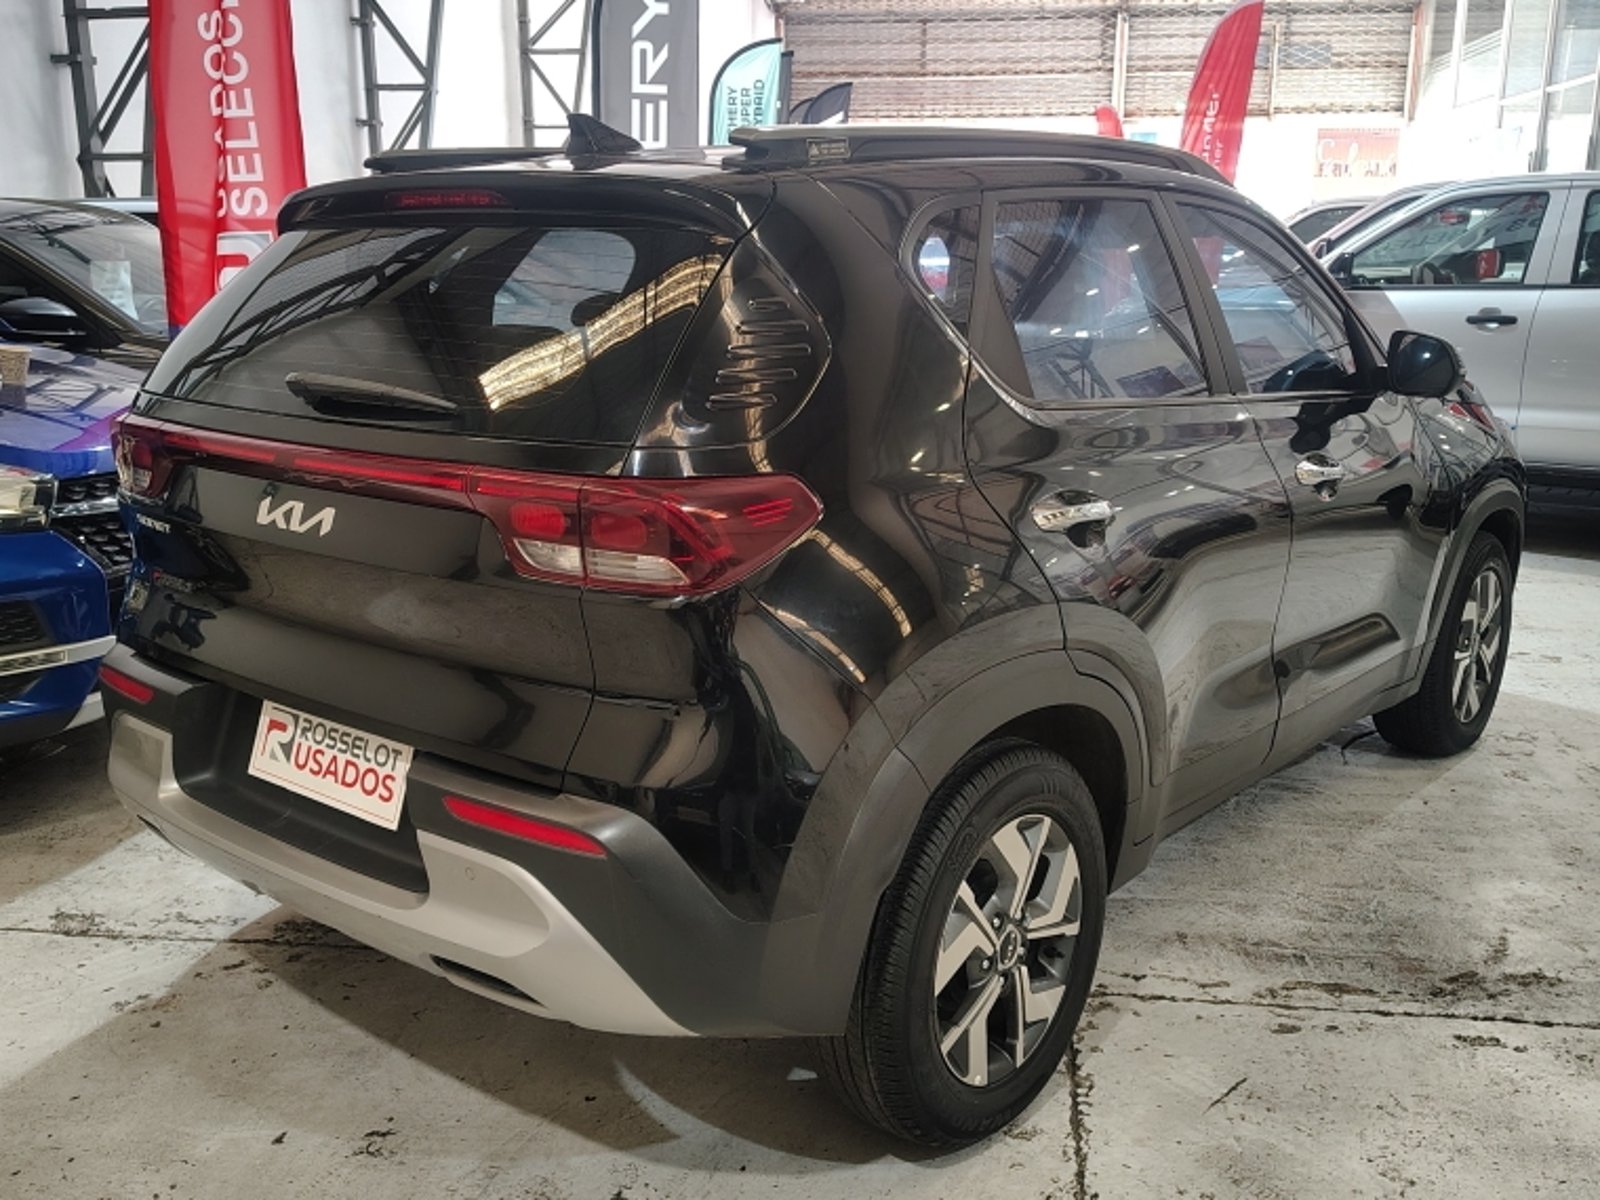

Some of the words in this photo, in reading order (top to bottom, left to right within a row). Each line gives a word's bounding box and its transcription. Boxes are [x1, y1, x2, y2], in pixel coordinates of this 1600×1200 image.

[727, 86, 738, 131] HERY
[740, 87, 751, 127] UPER
[753, 79, 765, 126] YBRID
[256, 495, 336, 537] KIA
[300, 718, 402, 772] ROSSELOT
[294, 742, 396, 803] USADOS
